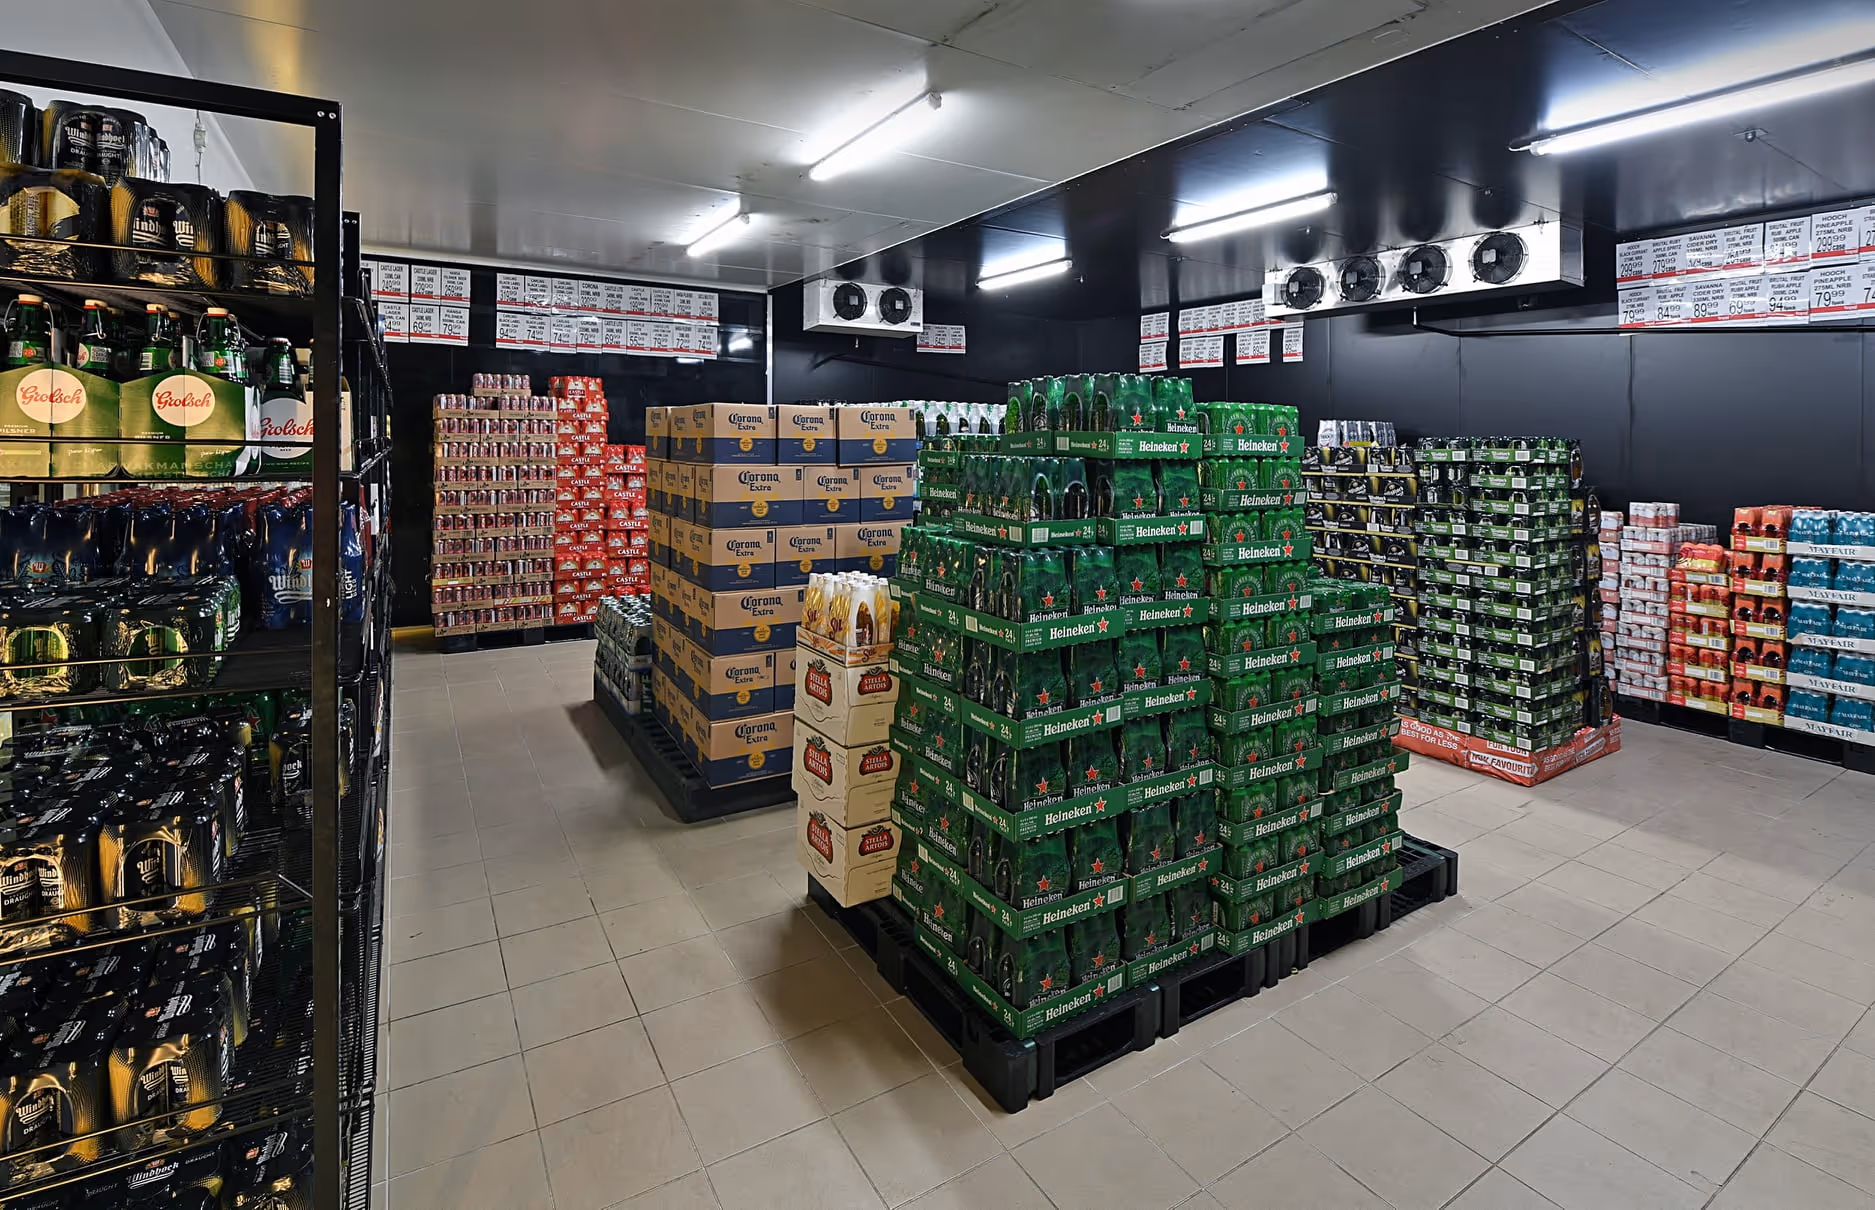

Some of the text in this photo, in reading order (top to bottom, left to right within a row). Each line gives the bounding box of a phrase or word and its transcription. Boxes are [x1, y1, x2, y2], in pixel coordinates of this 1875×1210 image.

[1815, 220, 1853, 229] PINEAPPLE
[1687, 239, 1718, 249] CIDER DRY
[1689, 233, 1717, 242] SAVANNA
[1695, 283, 1723, 291] SAVANNA
[1814, 276, 1852, 285] PINEAPPLE
[20, 386, 82, 405] Grolsch
[155, 390, 211, 409] Grolsch
[729, 412, 763, 425] Corona
[792, 414, 825, 426] Corona
[860, 410, 897, 423] Corona
[260, 417, 314, 437] Grolsch
[737, 423, 756, 431] Extra
[801, 424, 819, 432] Extra
[870, 422, 889, 430] Extra
[1139, 440, 1177, 453] Heineken
[1237, 438, 1279, 452] Heineken
[738, 470, 781, 486] Corona
[817, 475, 848, 486] Corona
[872, 474, 902, 485] Corona
[749, 483, 772, 492] Extra
[825, 485, 842, 493] Extra
[881, 483, 897, 491] Extra
[929, 487, 957, 499] Heineken
[1240, 492, 1282, 507] Heineken
[857, 527, 894, 540] Corona
[965, 523, 997, 537] Heineken
[1136, 524, 1175, 538] Heineken
[726, 540, 762, 552] Corona
[789, 536, 822, 548] Corona
[867, 539, 886, 547] Extra
[1238, 545, 1282, 560] Heineken
[1808, 546, 1856, 556] MAYFAIR
[1808, 590, 1856, 601] MAYFAIR
[741, 596, 783, 610] Corona
[1243, 600, 1287, 616] Heineken
[752, 608, 774, 616] Extra
[1140, 607, 1180, 620] Heineken
[1335, 615, 1373, 628] Heineken
[1049, 621, 1095, 640] Heineken
[1808, 637, 1855, 648] MAYFAIR
[1245, 651, 1288, 669] Heineken
[1337, 653, 1373, 669] Heineken
[725, 666, 761, 679] Corona
[734, 676, 754, 684] Extra
[809, 672, 828, 689] STELLA
[863, 682, 887, 691] ARTOIS
[864, 676, 887, 686] STELLA
[1809, 679, 1856, 693] MAYFAIR
[809, 682, 828, 698] ARTOIS
[1145, 689, 1187, 708] Heineken
[1343, 692, 1380, 709] Heineken
[1251, 708, 1293, 727] Heineken
[734, 722, 777, 738] Corona
[1044, 716, 1090, 736] Heineken
[1410, 722, 1432, 735] GOOD
[1433, 729, 1444, 737] AS
[1806, 722, 1853, 738] MAYFAIR
[746, 735, 768, 744] Extra
[1343, 731, 1380, 748] Heineken
[1401, 729, 1458, 750] BEST FOR LESS
[808, 750, 828, 767] STELLA
[865, 756, 888, 766] STELLA
[808, 760, 828, 777] ARTOIS
[864, 762, 888, 771] ARTOIS
[1250, 761, 1296, 781] Heineken
[1351, 766, 1387, 784] Heineken
[1144, 779, 1186, 799] Heineken
[1044, 803, 1092, 826] Heineken
[1345, 807, 1381, 826] Heineken
[811, 823, 828, 841] STELLA
[1255, 816, 1300, 836] Heineken
[811, 833, 829, 851] ARTOIS
[864, 840, 888, 851] ARTOIS
[865, 834, 888, 846] STELLA
[1346, 847, 1382, 869] Heineken
[1157, 866, 1197, 886] Heineken
[1257, 867, 1300, 892] Heineken
[1343, 886, 1380, 908] Heineken
[1042, 901, 1090, 925] Heineken
[1252, 919, 1295, 945] Heineken
[1148, 949, 1188, 974] Heineken
[1045, 992, 1092, 1021] Heineken
[126, 1161, 179, 1185] Windhoek
